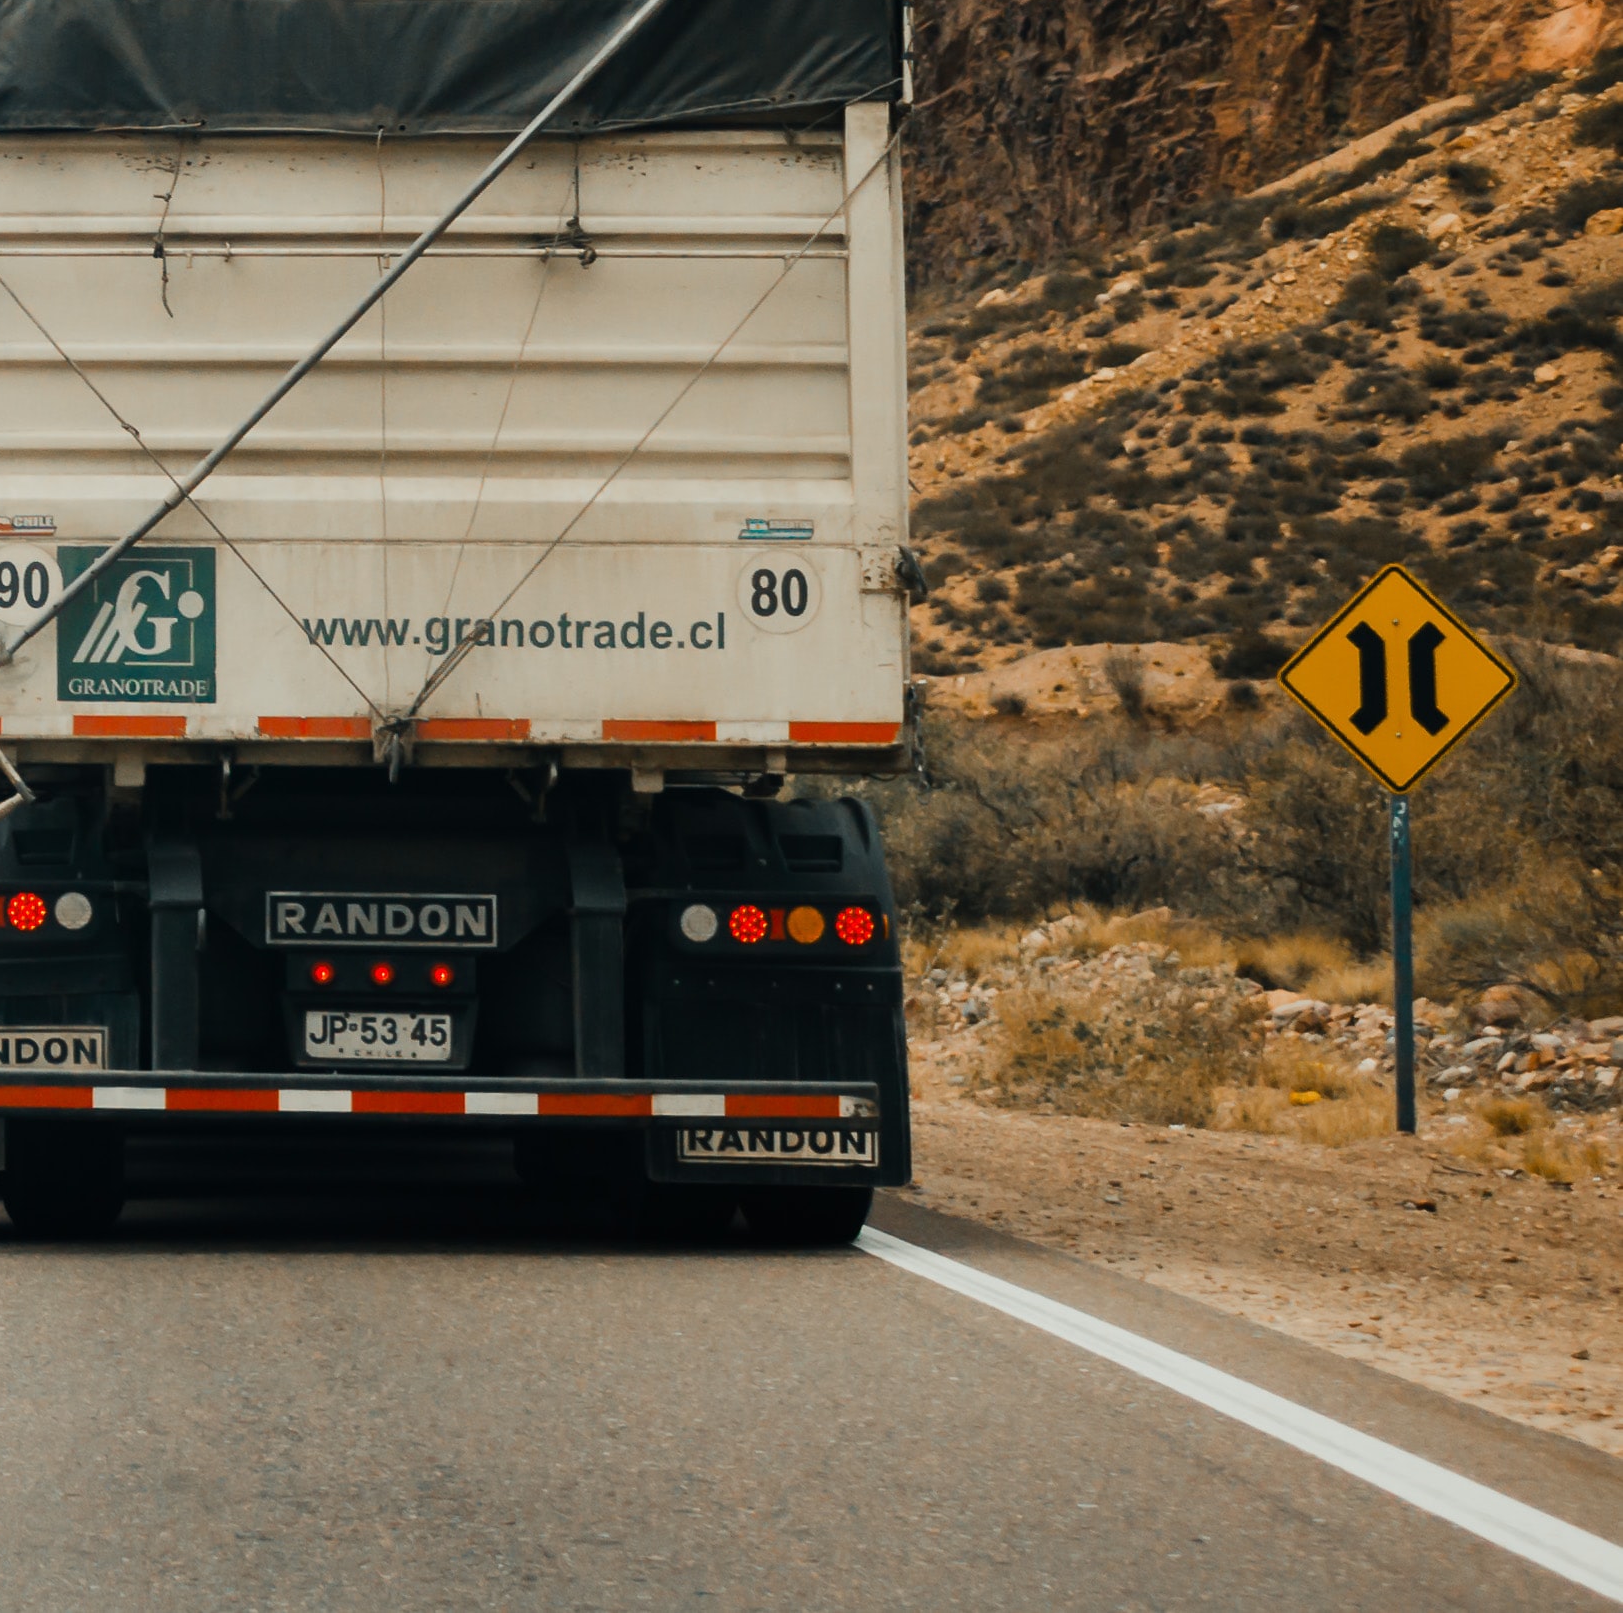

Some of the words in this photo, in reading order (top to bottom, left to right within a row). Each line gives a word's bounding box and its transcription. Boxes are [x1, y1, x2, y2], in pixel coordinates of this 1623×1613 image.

[13, 515, 54, 527] CHILE
[751, 568, 808, 617] 80
[301, 611, 726, 656] www.granotrade.cl
[68, 678, 208, 697] GRANOTRADE
[276, 901, 487, 937] RANDON
[355, 1049, 402, 1058] CHILE
[687, 1129, 867, 1155] RANDON
